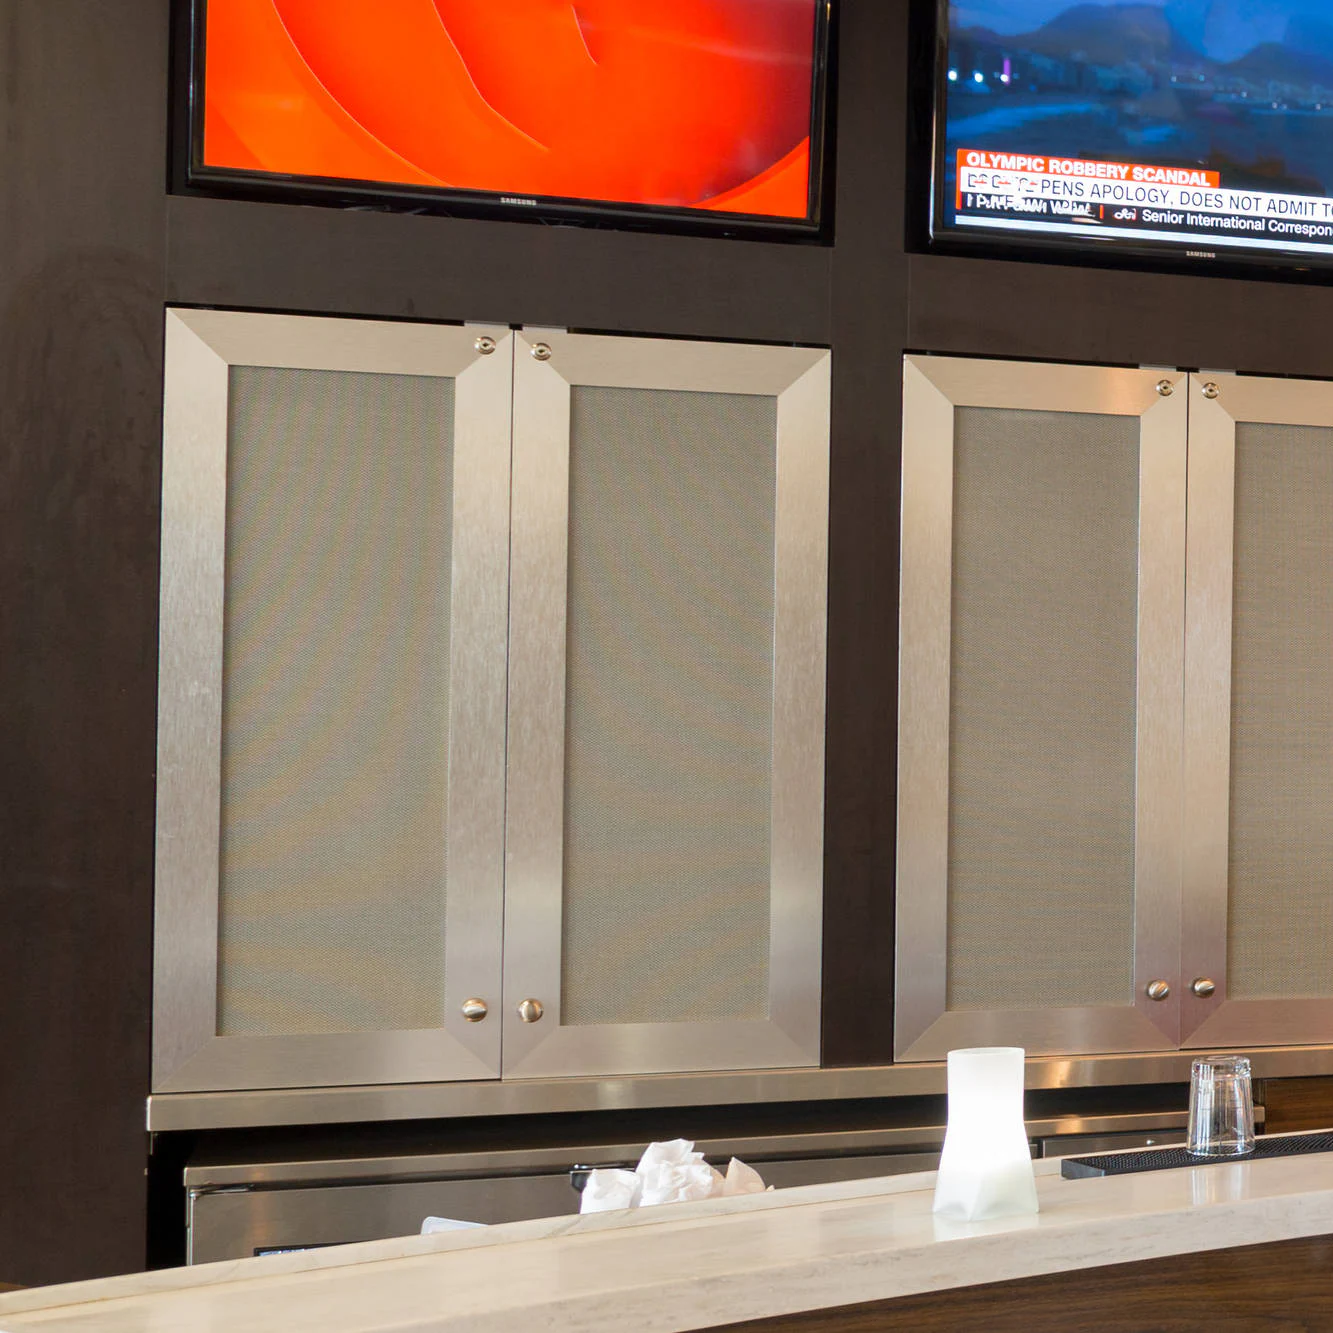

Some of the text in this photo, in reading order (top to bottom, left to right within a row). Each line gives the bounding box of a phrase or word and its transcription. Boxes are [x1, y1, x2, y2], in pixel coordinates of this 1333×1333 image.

[967, 152, 1210, 187] OLYMPIC ROBBERY SCANDAL
[1091, 184, 1174, 205] APOLOGY,
[1180, 191, 1223, 209] DOES
[1230, 195, 1261, 211] NOT
[1267, 199, 1316, 216] ADMIT
[1142, 208, 1183, 225] Senior
[1187, 213, 1265, 231] International
